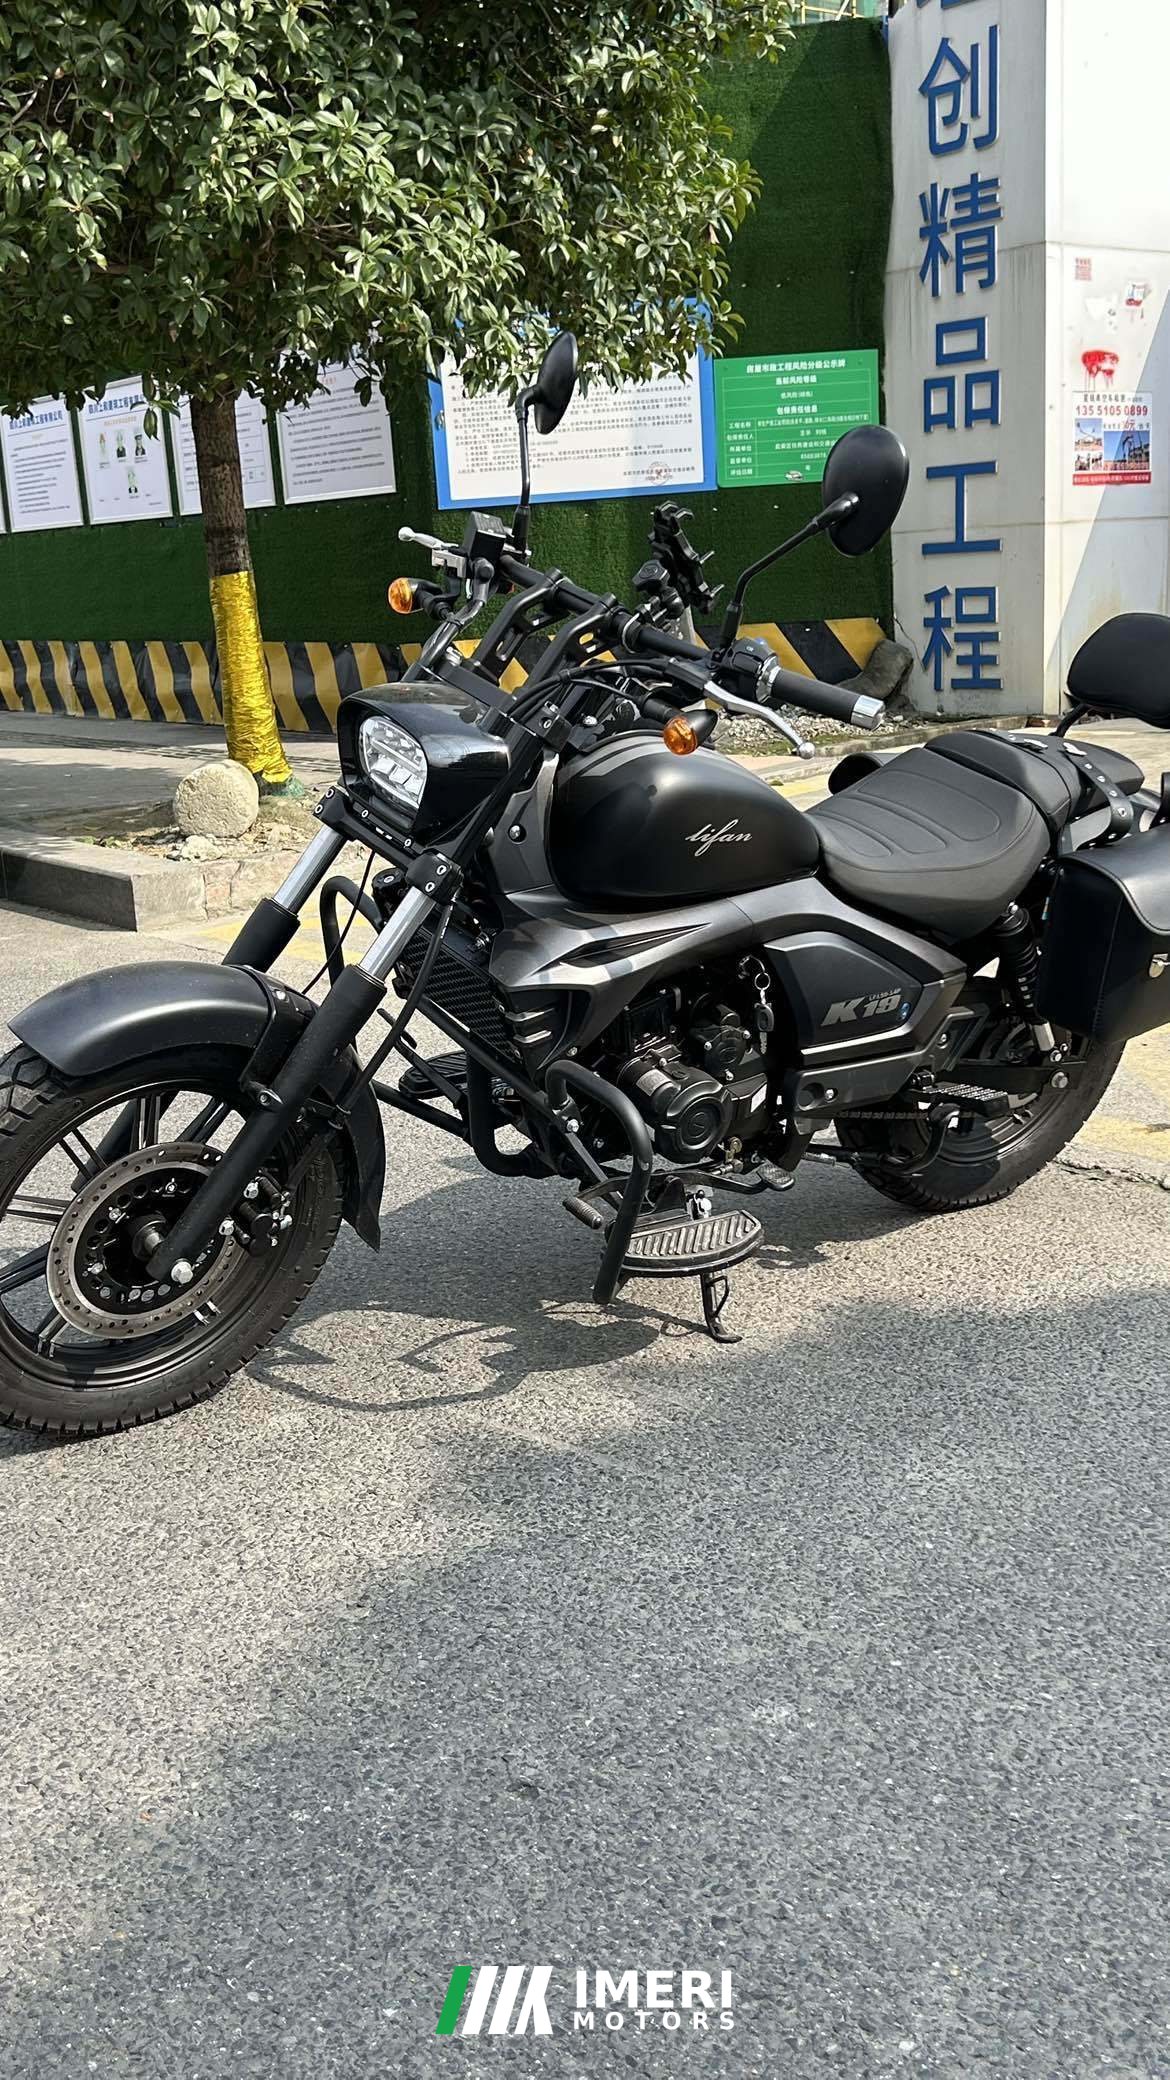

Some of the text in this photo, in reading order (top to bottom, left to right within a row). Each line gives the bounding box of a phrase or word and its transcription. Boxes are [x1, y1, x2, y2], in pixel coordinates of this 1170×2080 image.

[917, 0, 1003, 692] 创精品工程
[1076, 405, 1094, 416] 135
[1124, 404, 1148, 416] 0899
